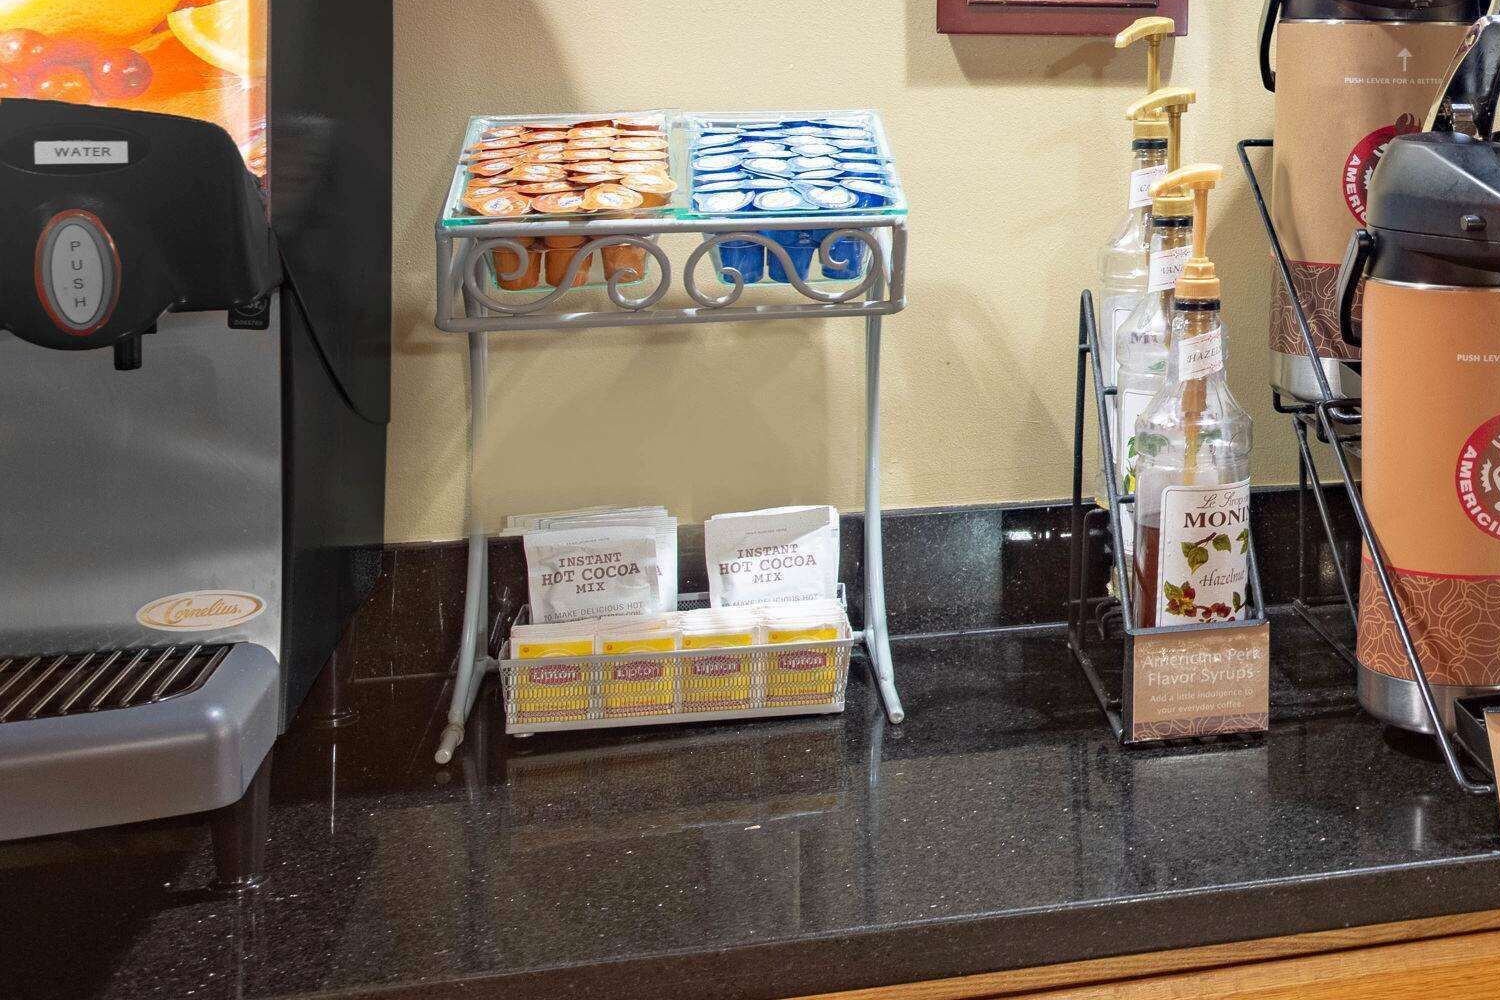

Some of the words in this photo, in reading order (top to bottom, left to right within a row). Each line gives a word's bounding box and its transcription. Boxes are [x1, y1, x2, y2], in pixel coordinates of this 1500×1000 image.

[54, 147, 112, 157] WATER
[1346, 154, 1367, 221] AMERIC
[70, 241, 87, 307] PUSH
[1456, 354, 1481, 362] PUSH
[737, 543, 798, 559] INSTANT
[558, 552, 622, 568] INSTANT
[719, 561, 753, 575] HOT
[760, 554, 817, 571] COCOA
[541, 570, 575, 587] HOT
[581, 562, 641, 581] COCOA
[753, 572, 783, 584] MIX
[576, 581, 606, 594] MIX
[164, 598, 242, 625] Cornelius
[580, 604, 624, 616] DELICIOUS
[627, 601, 644, 610] HOT
[1148, 671, 1196, 687] Flavor
[1200, 667, 1255, 684] Syrups
